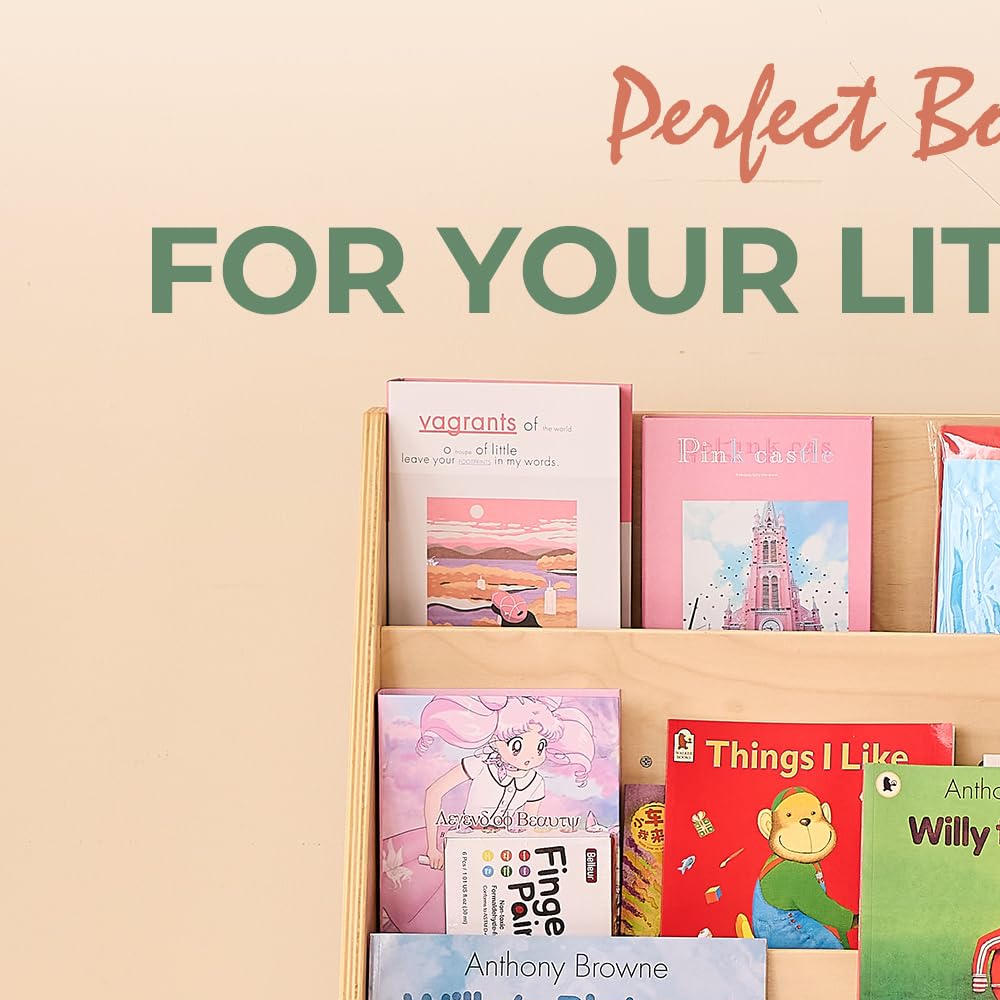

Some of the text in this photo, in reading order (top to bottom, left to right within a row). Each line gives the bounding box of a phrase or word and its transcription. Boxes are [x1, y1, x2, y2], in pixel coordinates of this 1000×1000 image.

[419, 413, 517, 436] vagrants
[523, 416, 538, 432] of
[401, 452, 429, 464] leave
[432, 456, 455, 467] your
[494, 455, 504, 465] in
[507, 458, 521, 468] my
[524, 456, 560, 467] words.
[476, 442, 488, 455] of
[491, 443, 518, 456] little
[678, 437, 834, 464] Pink castle
[705, 739, 909, 779] Things I Like
[908, 815, 991, 857] Willy
[534, 845, 567, 937] Finge
[490, 884, 498, 936] Formaldehyde-f
[464, 950, 669, 985] Anthony Browne
